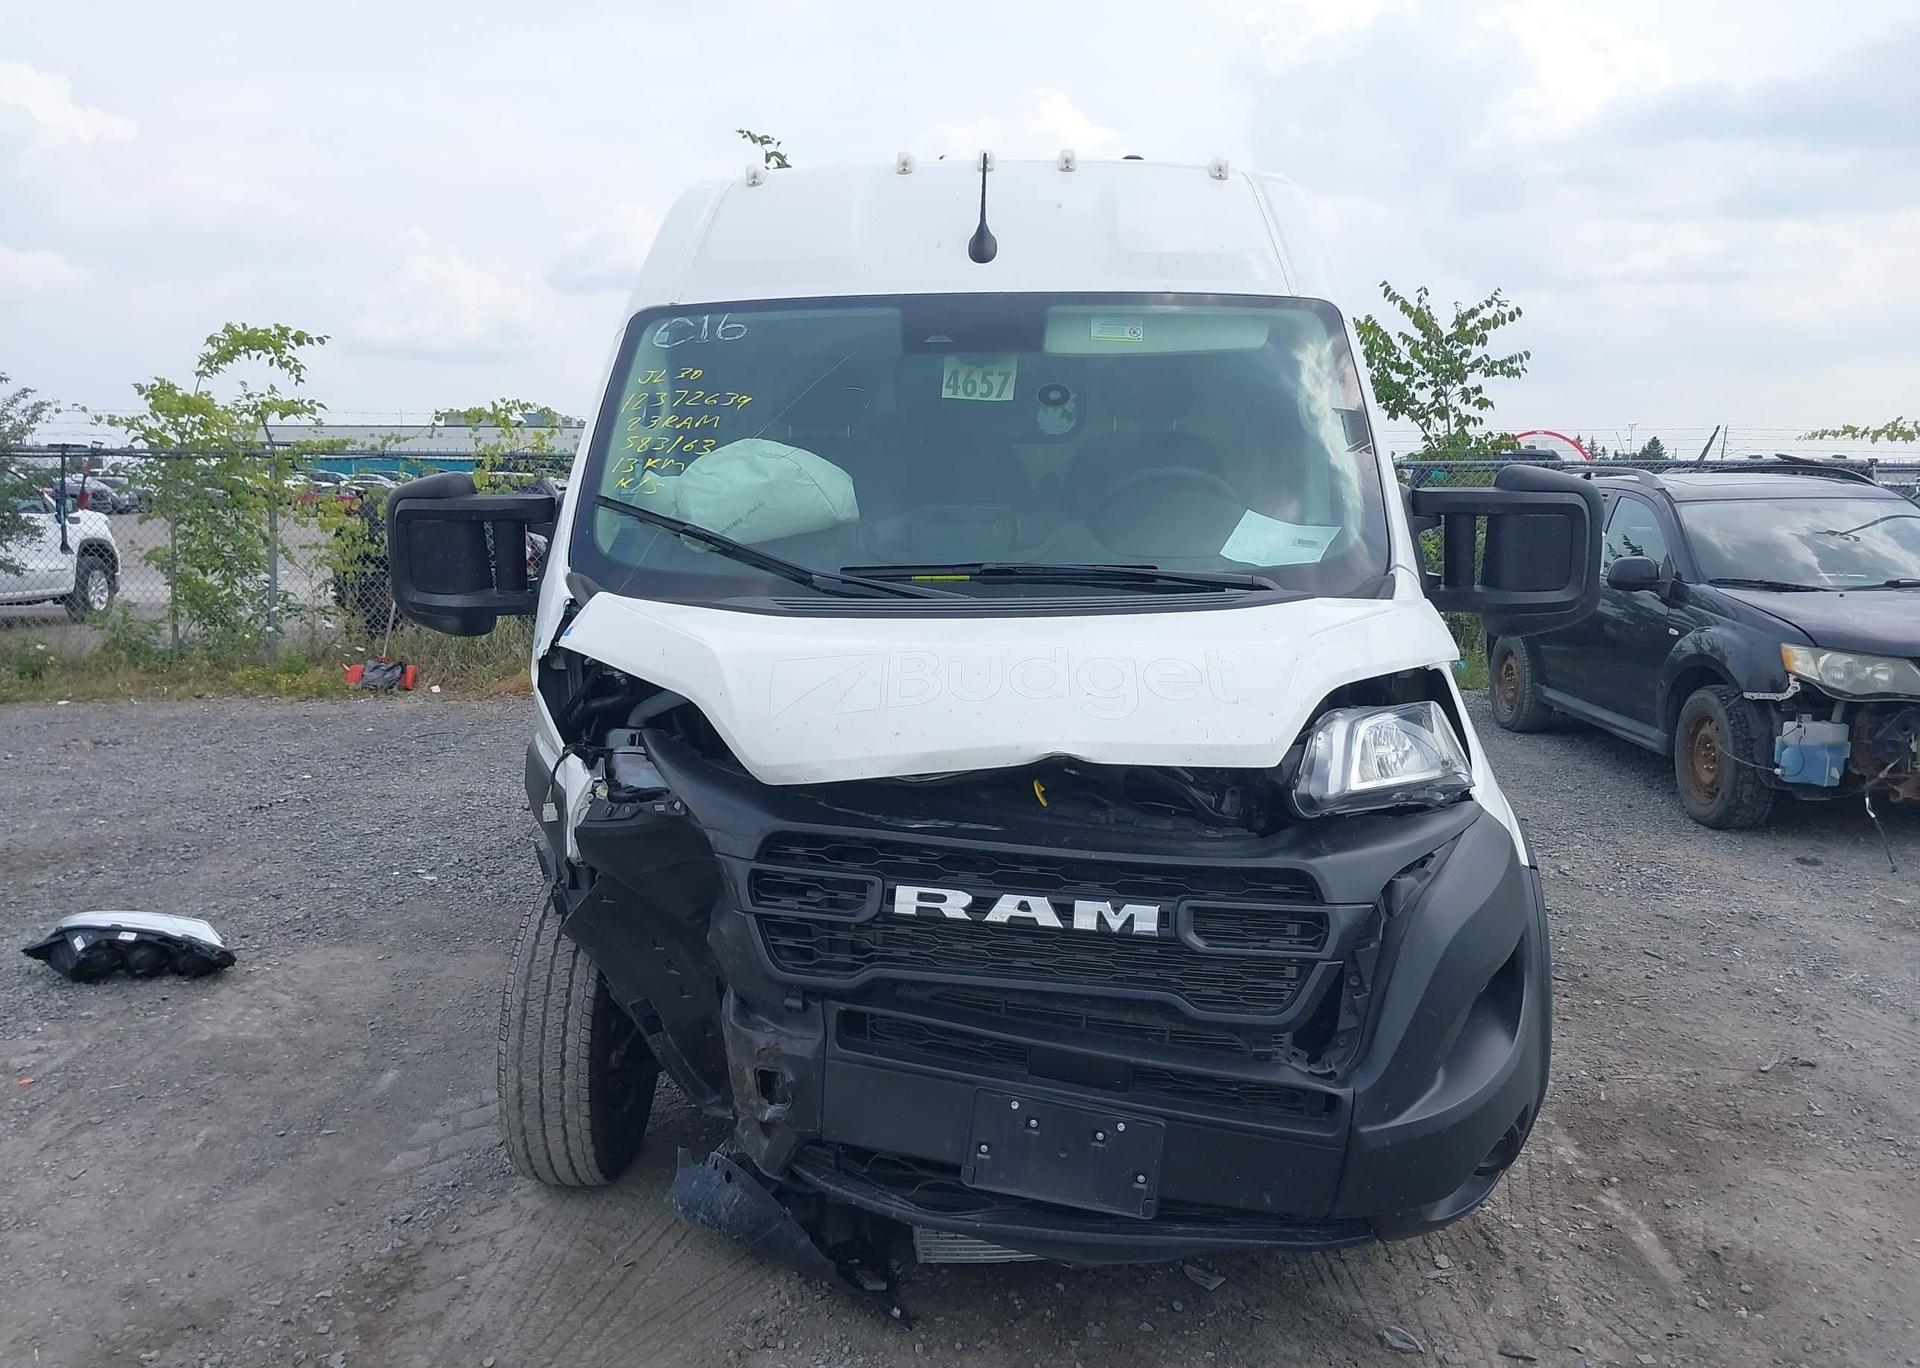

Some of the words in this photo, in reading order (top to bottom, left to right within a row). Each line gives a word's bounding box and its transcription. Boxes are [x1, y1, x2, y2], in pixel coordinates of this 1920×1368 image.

[652, 312, 749, 349] C16
[944, 369, 1013, 399] 4657
[886, 647, 1239, 720] Budget
[894, 885, 1160, 937] RAM
